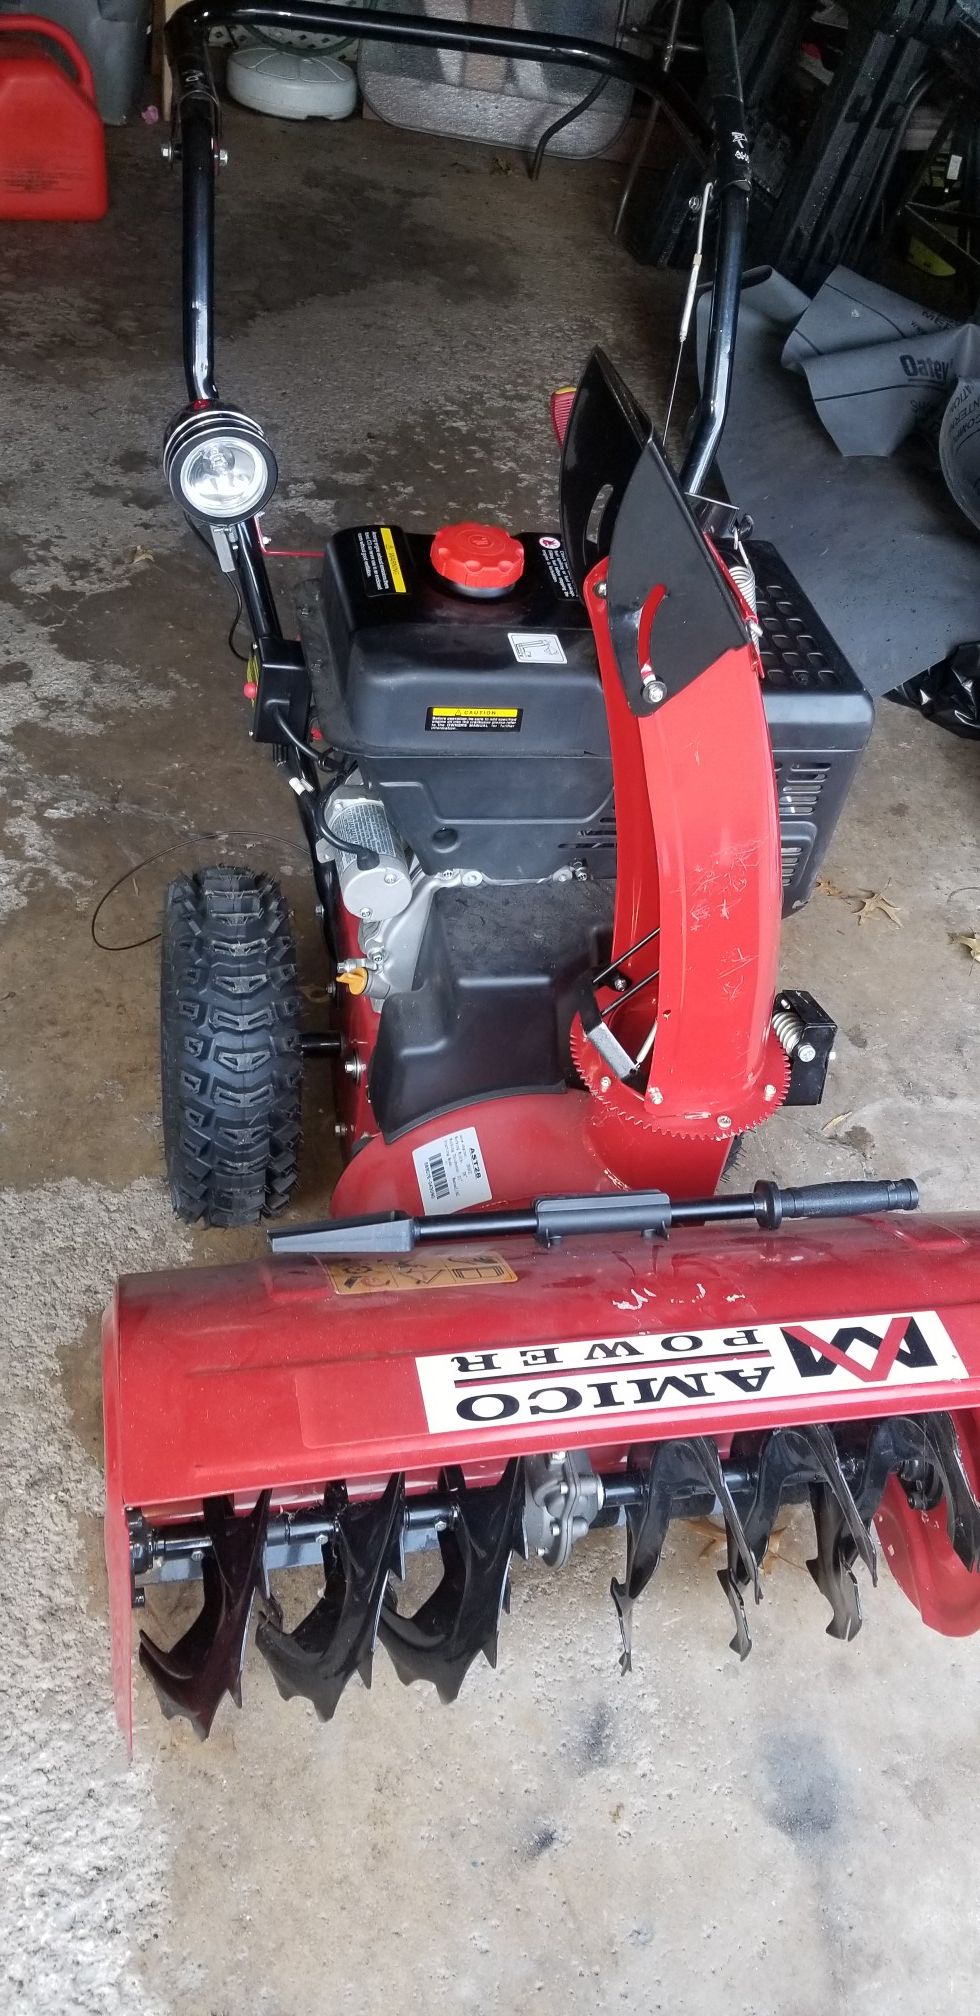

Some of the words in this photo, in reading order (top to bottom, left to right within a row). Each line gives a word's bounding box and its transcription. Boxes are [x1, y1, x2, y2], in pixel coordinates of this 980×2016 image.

[900, 354, 949, 381] Oatey
[450, 1328, 759, 1373] POWER
[455, 1365, 775, 1423] AMICO
